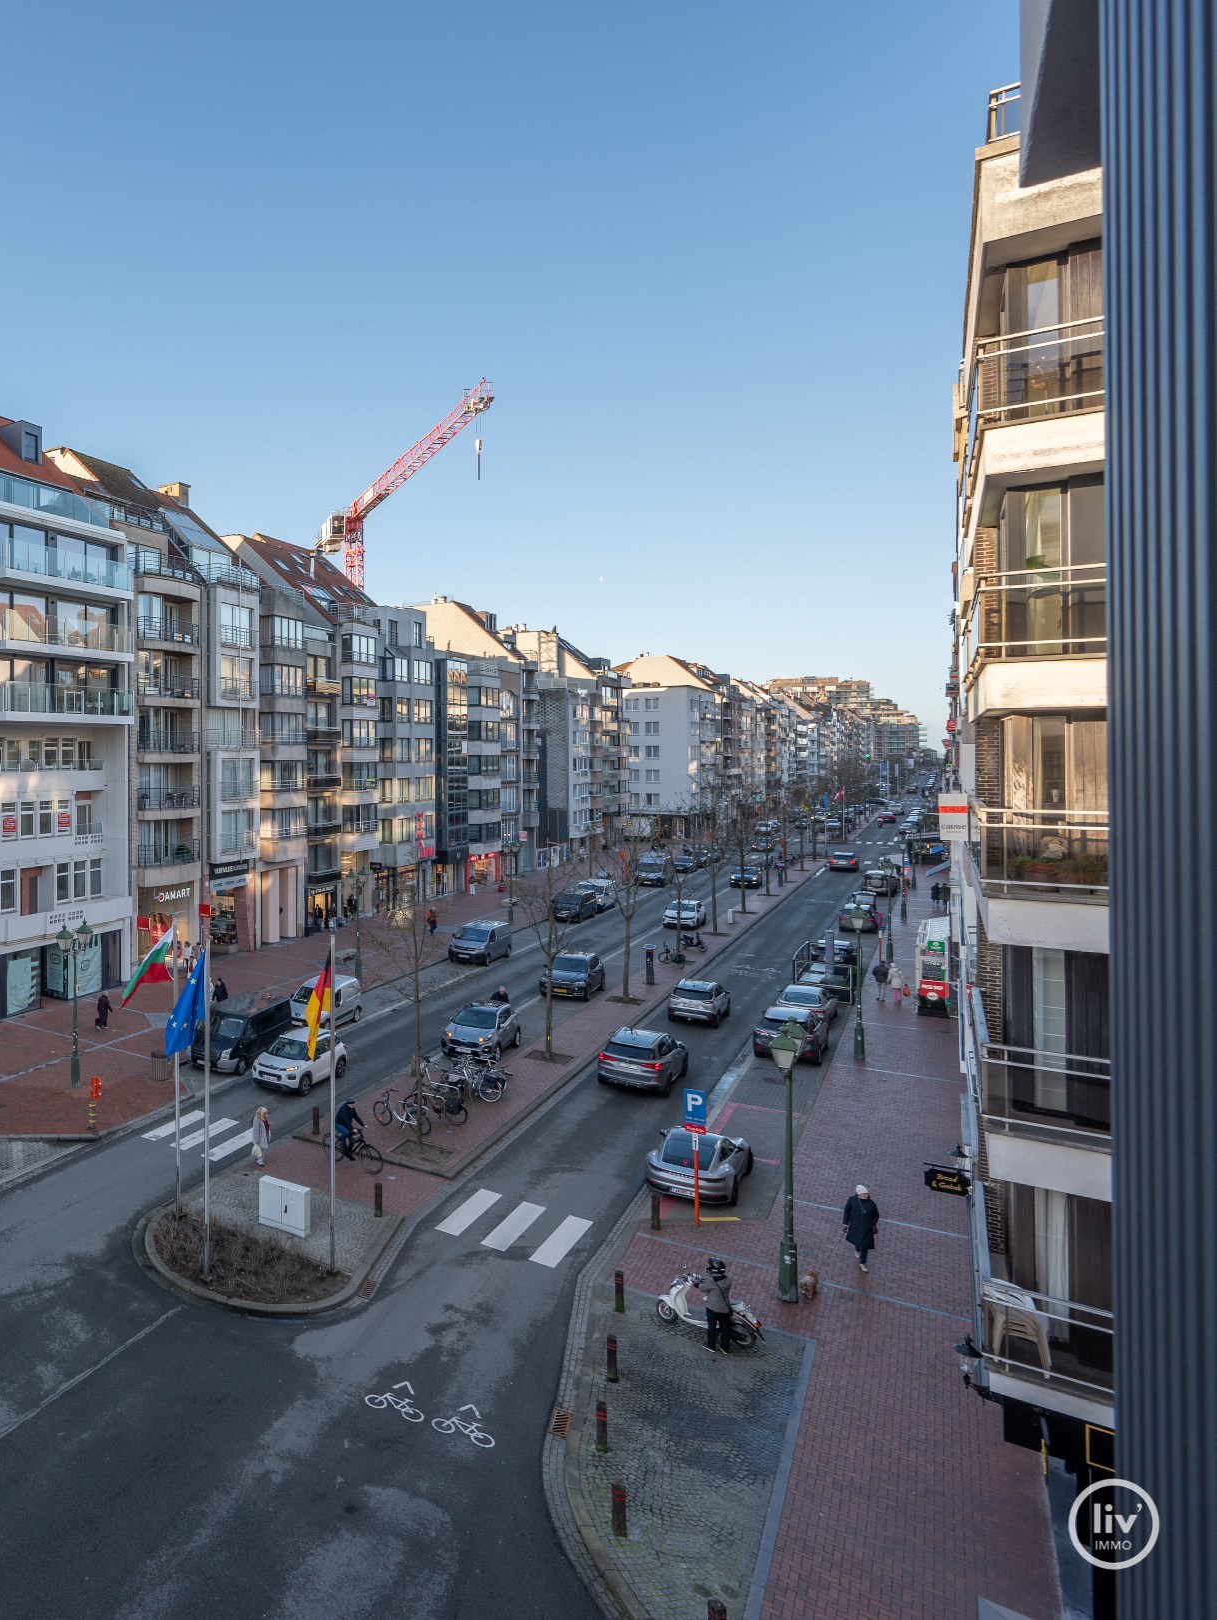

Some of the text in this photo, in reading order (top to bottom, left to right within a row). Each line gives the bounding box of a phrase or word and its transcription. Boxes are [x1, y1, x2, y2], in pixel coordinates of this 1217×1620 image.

[158, 887, 191, 903] DAMART
[686, 1093, 703, 1112] P
[936, 1173, 959, 1182] Brood
[931, 1180, 962, 1192] & Gebak
